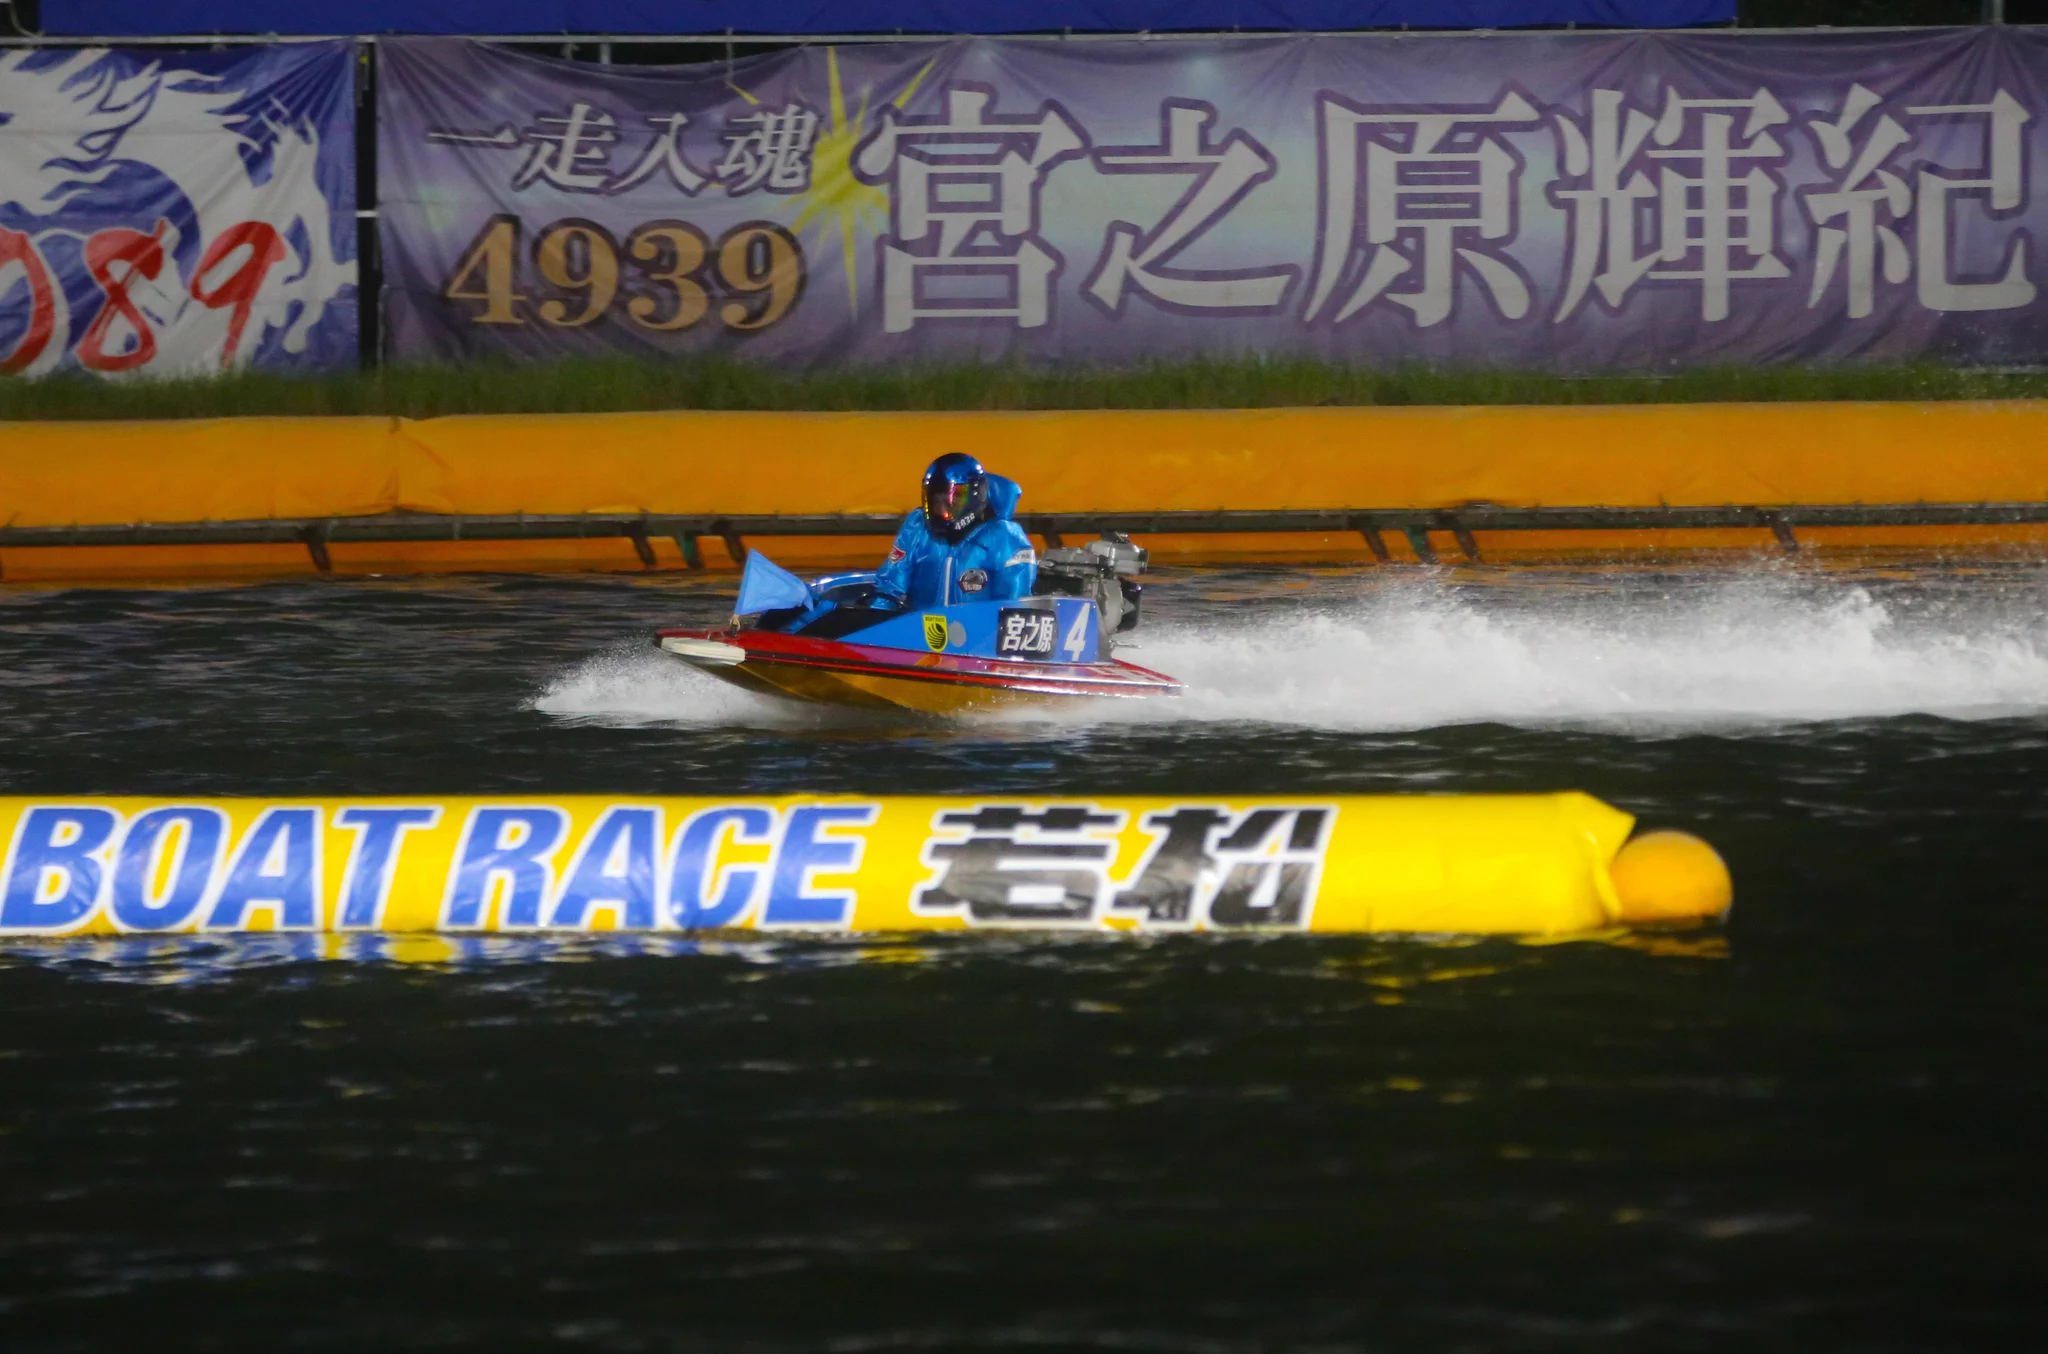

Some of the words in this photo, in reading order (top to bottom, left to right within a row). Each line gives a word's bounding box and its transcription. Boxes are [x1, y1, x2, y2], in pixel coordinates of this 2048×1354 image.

[427, 103, 818, 192] 一走入魂
[857, 83, 2036, 333] 宮之原輝紀
[446, 220, 801, 331] 4939
[1002, 614, 1055, 652] 宮之原
[1064, 602, 1091, 661] 4
[0, 806, 443, 932] BOAT
[436, 804, 881, 931] RACE
